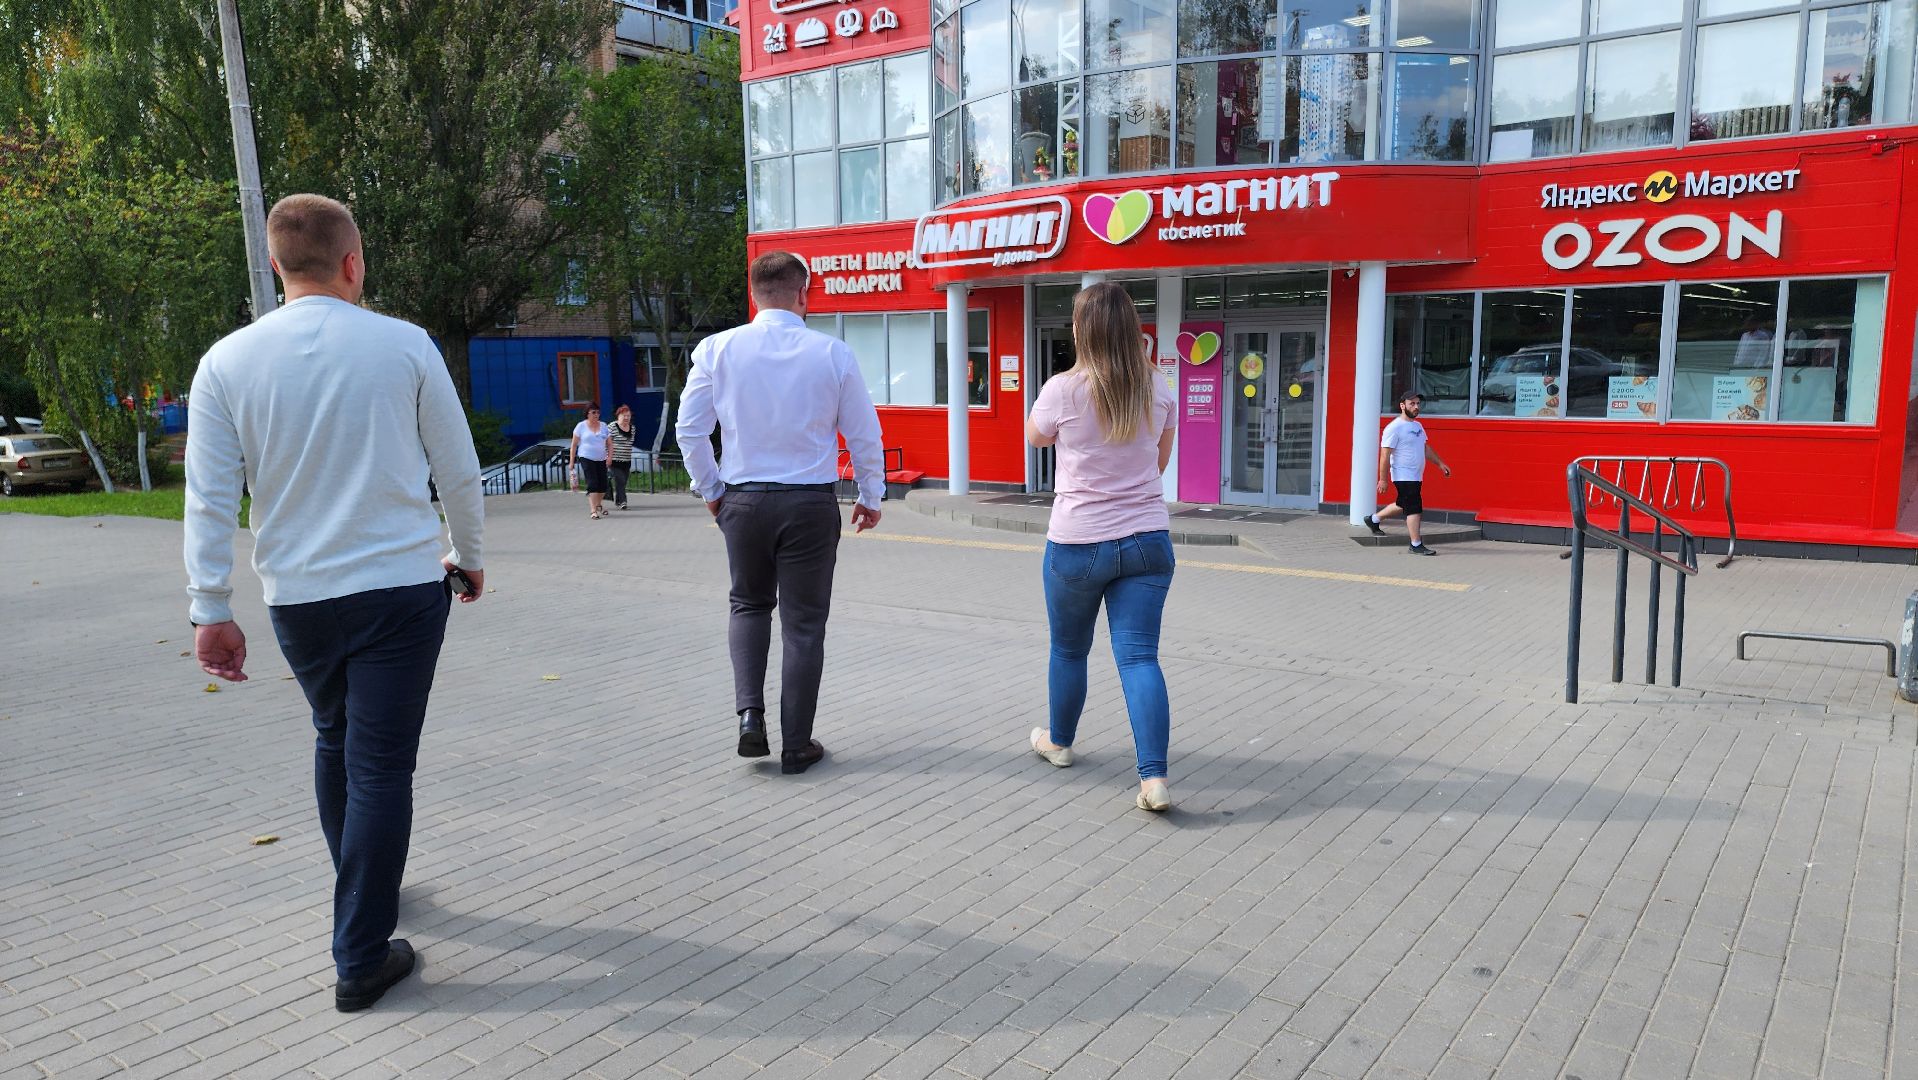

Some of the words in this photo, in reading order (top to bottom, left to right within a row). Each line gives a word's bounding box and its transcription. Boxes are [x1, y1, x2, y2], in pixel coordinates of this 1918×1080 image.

[763, 22, 787, 44] 24
[763, 41, 787, 53] ЧАСА
[1541, 182, 1637, 208] Яндекс
[1684, 169, 1801, 198] Маркет
[920, 211, 1059, 255] МАГНИТ
[1158, 222, 1246, 241] косметик
[1541, 209, 1783, 270] OZON
[811, 254, 862, 275] ЦВЕТЫ
[824, 273, 902, 294] ПОДАРКИ
